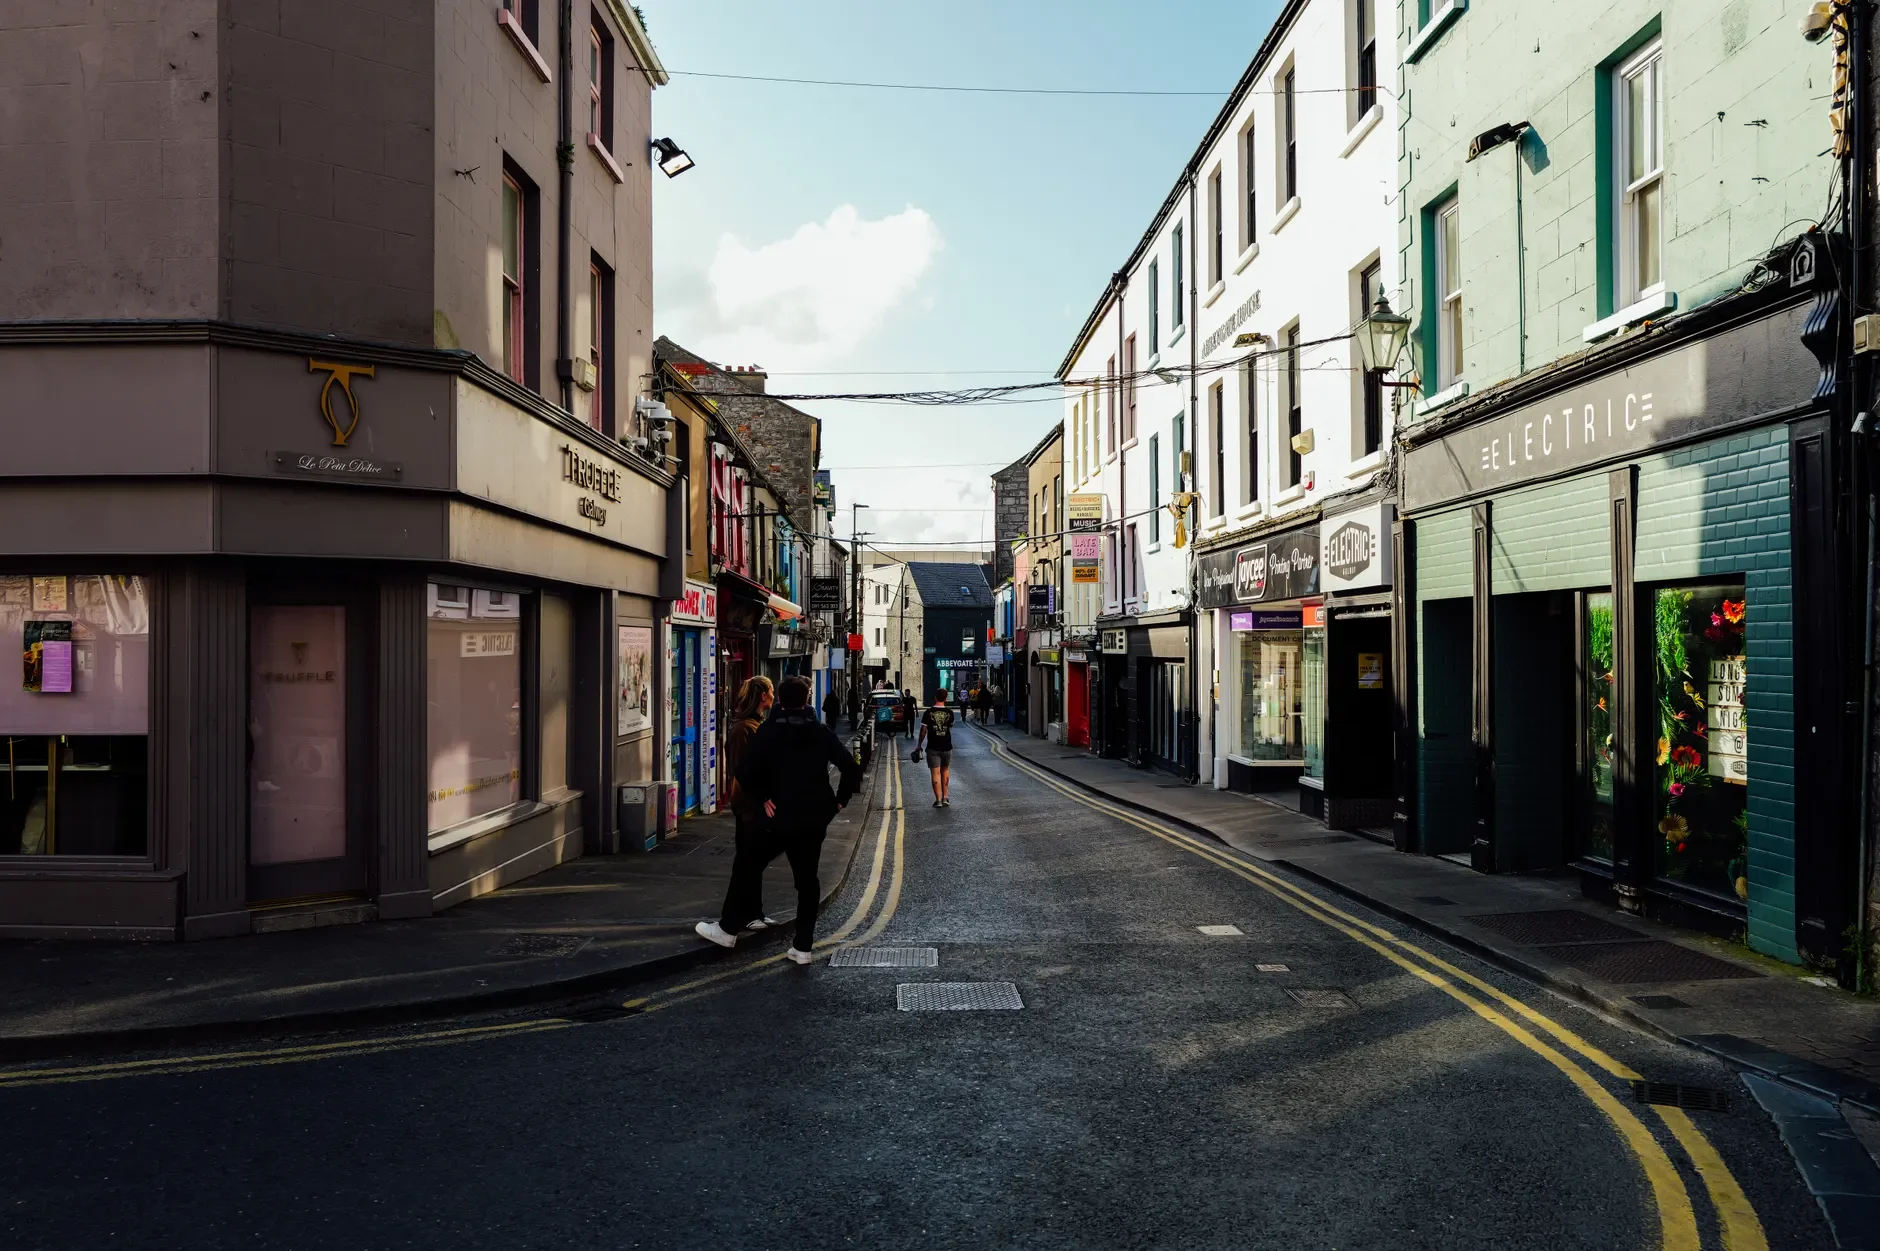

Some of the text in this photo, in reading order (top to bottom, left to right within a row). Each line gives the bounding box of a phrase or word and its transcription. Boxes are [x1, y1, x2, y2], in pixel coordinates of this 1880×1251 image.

[1491, 393, 1637, 471] ELECTRIC
[297, 455, 315, 470] Le
[318, 456, 346, 472] Petit
[559, 444, 621, 504] TRUFFLE
[578, 497, 607, 527] Galway
[1073, 520, 1097, 528] MUSIC
[1075, 538, 1097, 548] LATE
[1076, 548, 1095, 557] BAR
[1330, 527, 1368, 568] ELECTRIC
[1238, 554, 1265, 592] jaycee
[1269, 547, 1315, 579] Printing Partner
[811, 582, 839, 591] GRAVITY
[706, 594, 716, 618] FIX
[936, 659, 974, 668] ABBEYGATE
[1713, 662, 1740, 681] LONG
